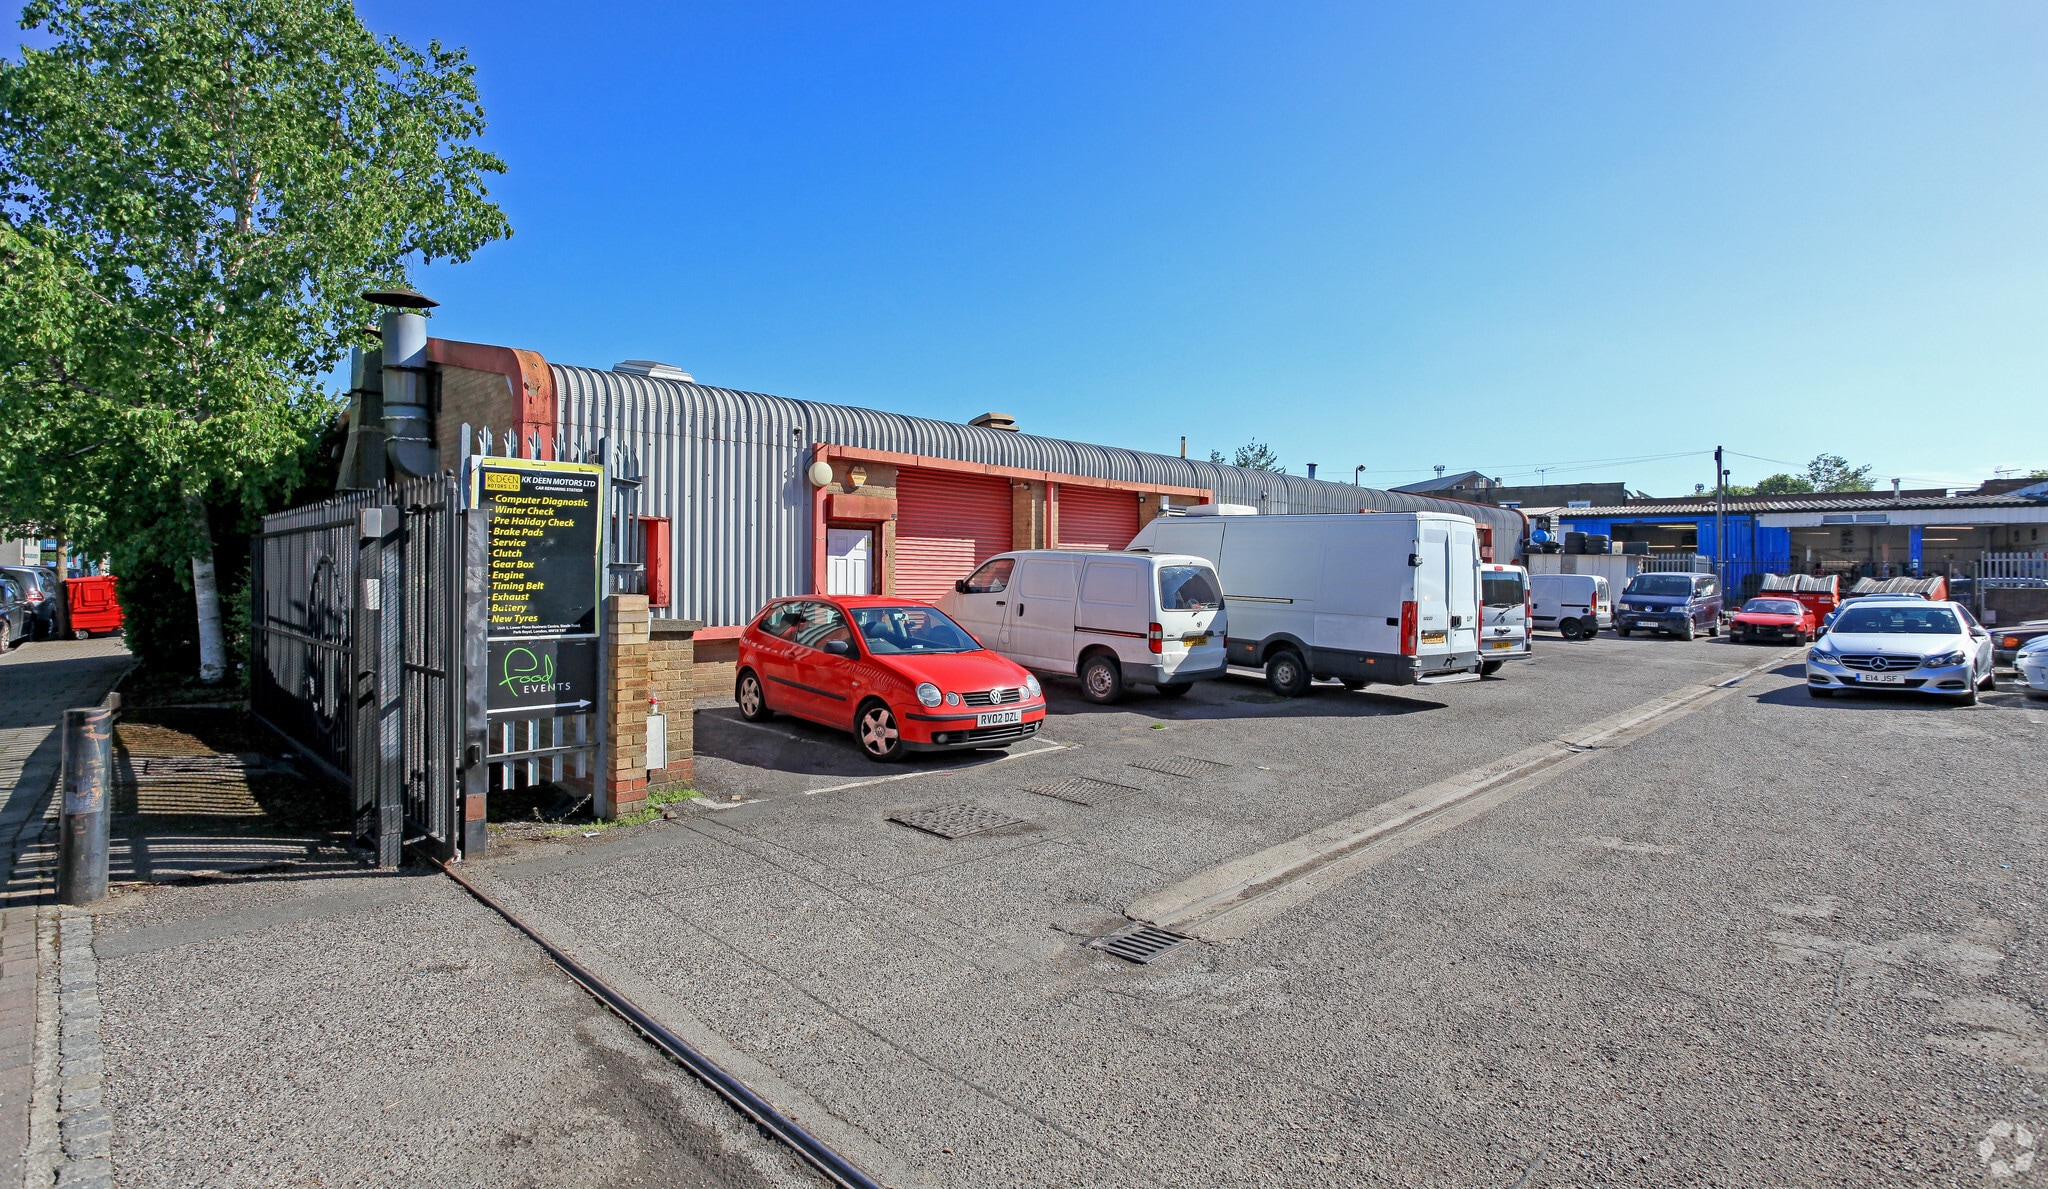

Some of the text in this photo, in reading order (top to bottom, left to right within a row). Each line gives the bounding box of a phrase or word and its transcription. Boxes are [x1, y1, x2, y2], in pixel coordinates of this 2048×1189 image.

[553, 478, 583, 487] MOTORS
[495, 495, 588, 507] Computer Diagnostic
[495, 506, 554, 516] Winter Check
[512, 517, 547, 527] Holiday
[548, 518, 574, 527] Check
[493, 528, 543, 537] Brake Pads
[493, 539, 526, 547] Service
[493, 549, 522, 558] Clutch
[493, 560, 534, 569] Gear Box
[492, 571, 524, 581] Engine
[493, 582, 544, 592] Timing Belt
[492, 593, 530, 601] Exhaust
[492, 604, 527, 613] Battery
[492, 614, 538, 624] New Tyres
[524, 682, 571, 694] EVENTS
[981, 711, 1018, 725] RV02 DZL
